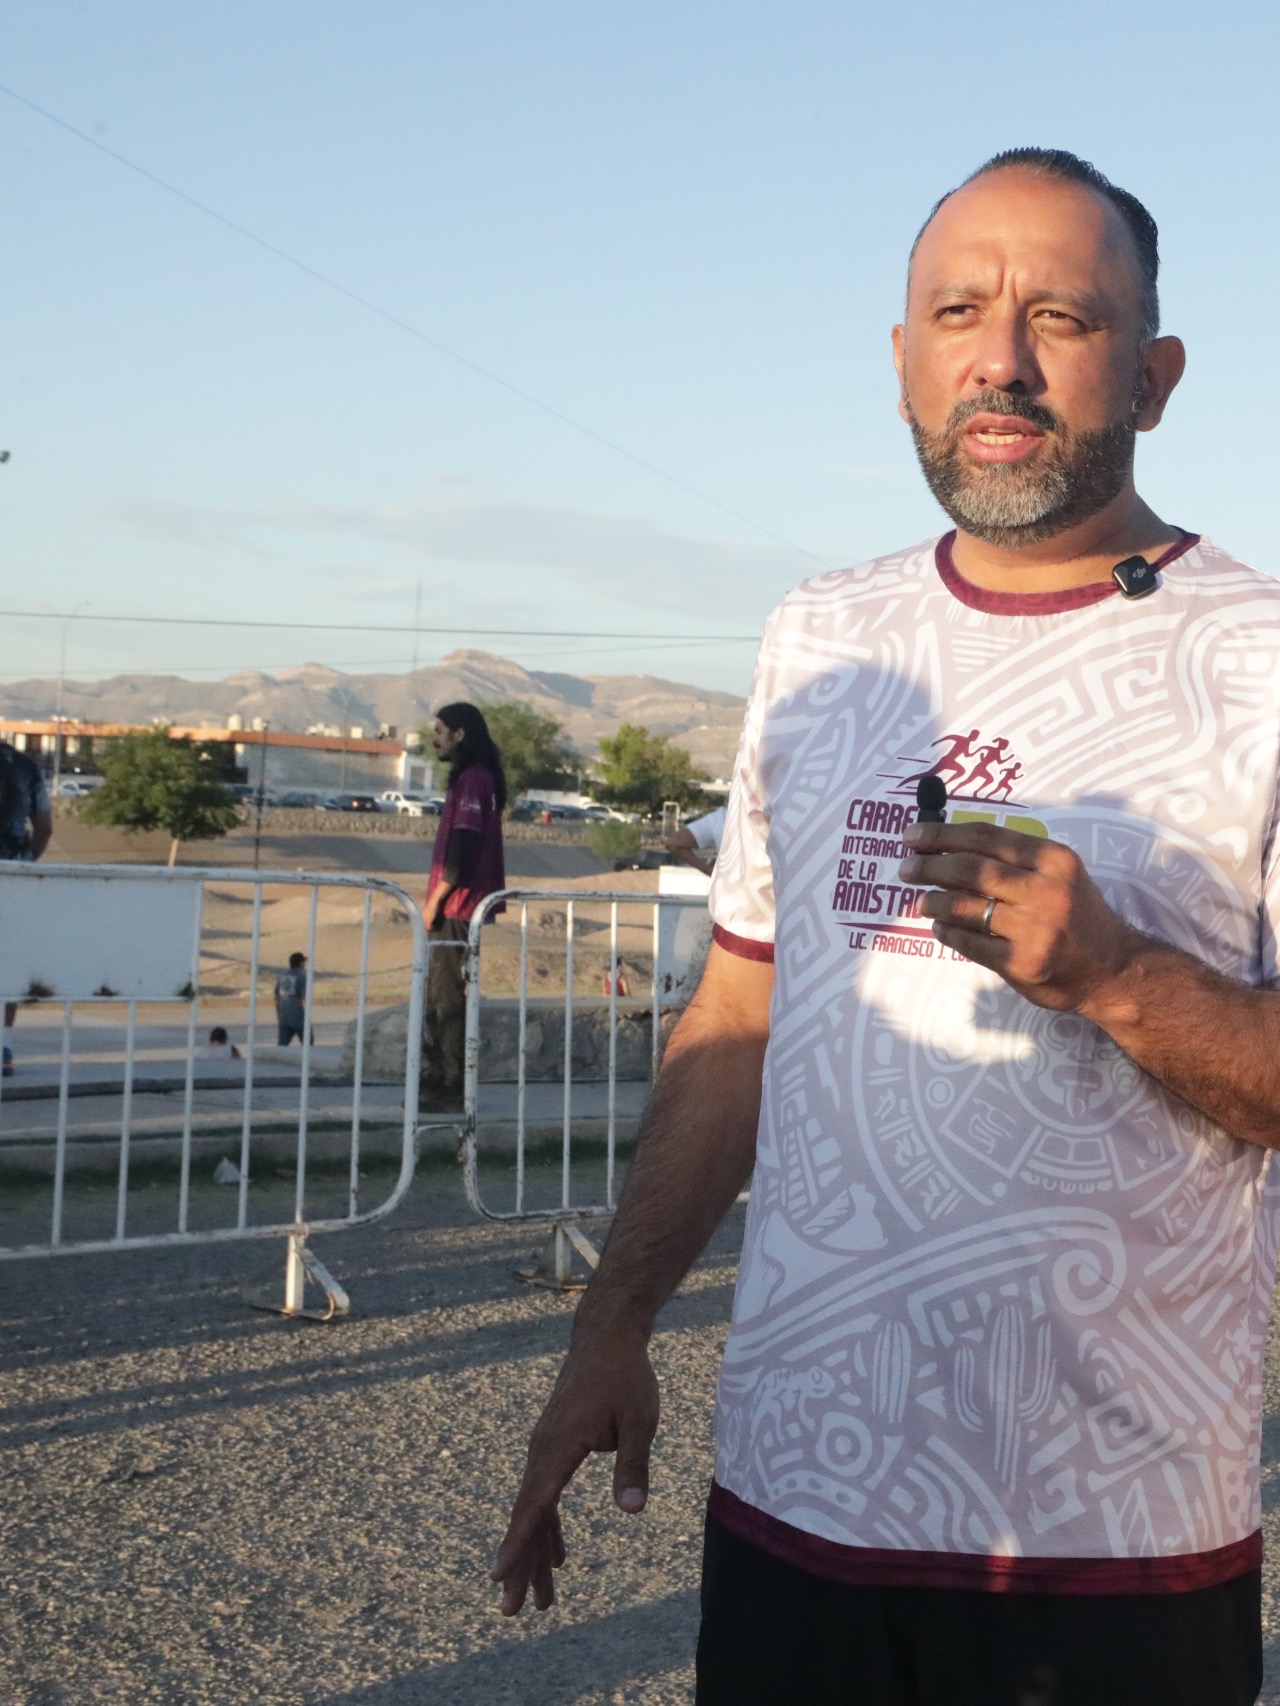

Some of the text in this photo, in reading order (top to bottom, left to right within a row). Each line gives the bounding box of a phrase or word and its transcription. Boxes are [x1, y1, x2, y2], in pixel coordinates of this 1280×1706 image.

[846, 798, 919, 835] CARRE
[837, 859, 878, 882] DE LA
[848, 930, 868, 951] LIC.
[871, 933, 934, 958] FRANCISCO
